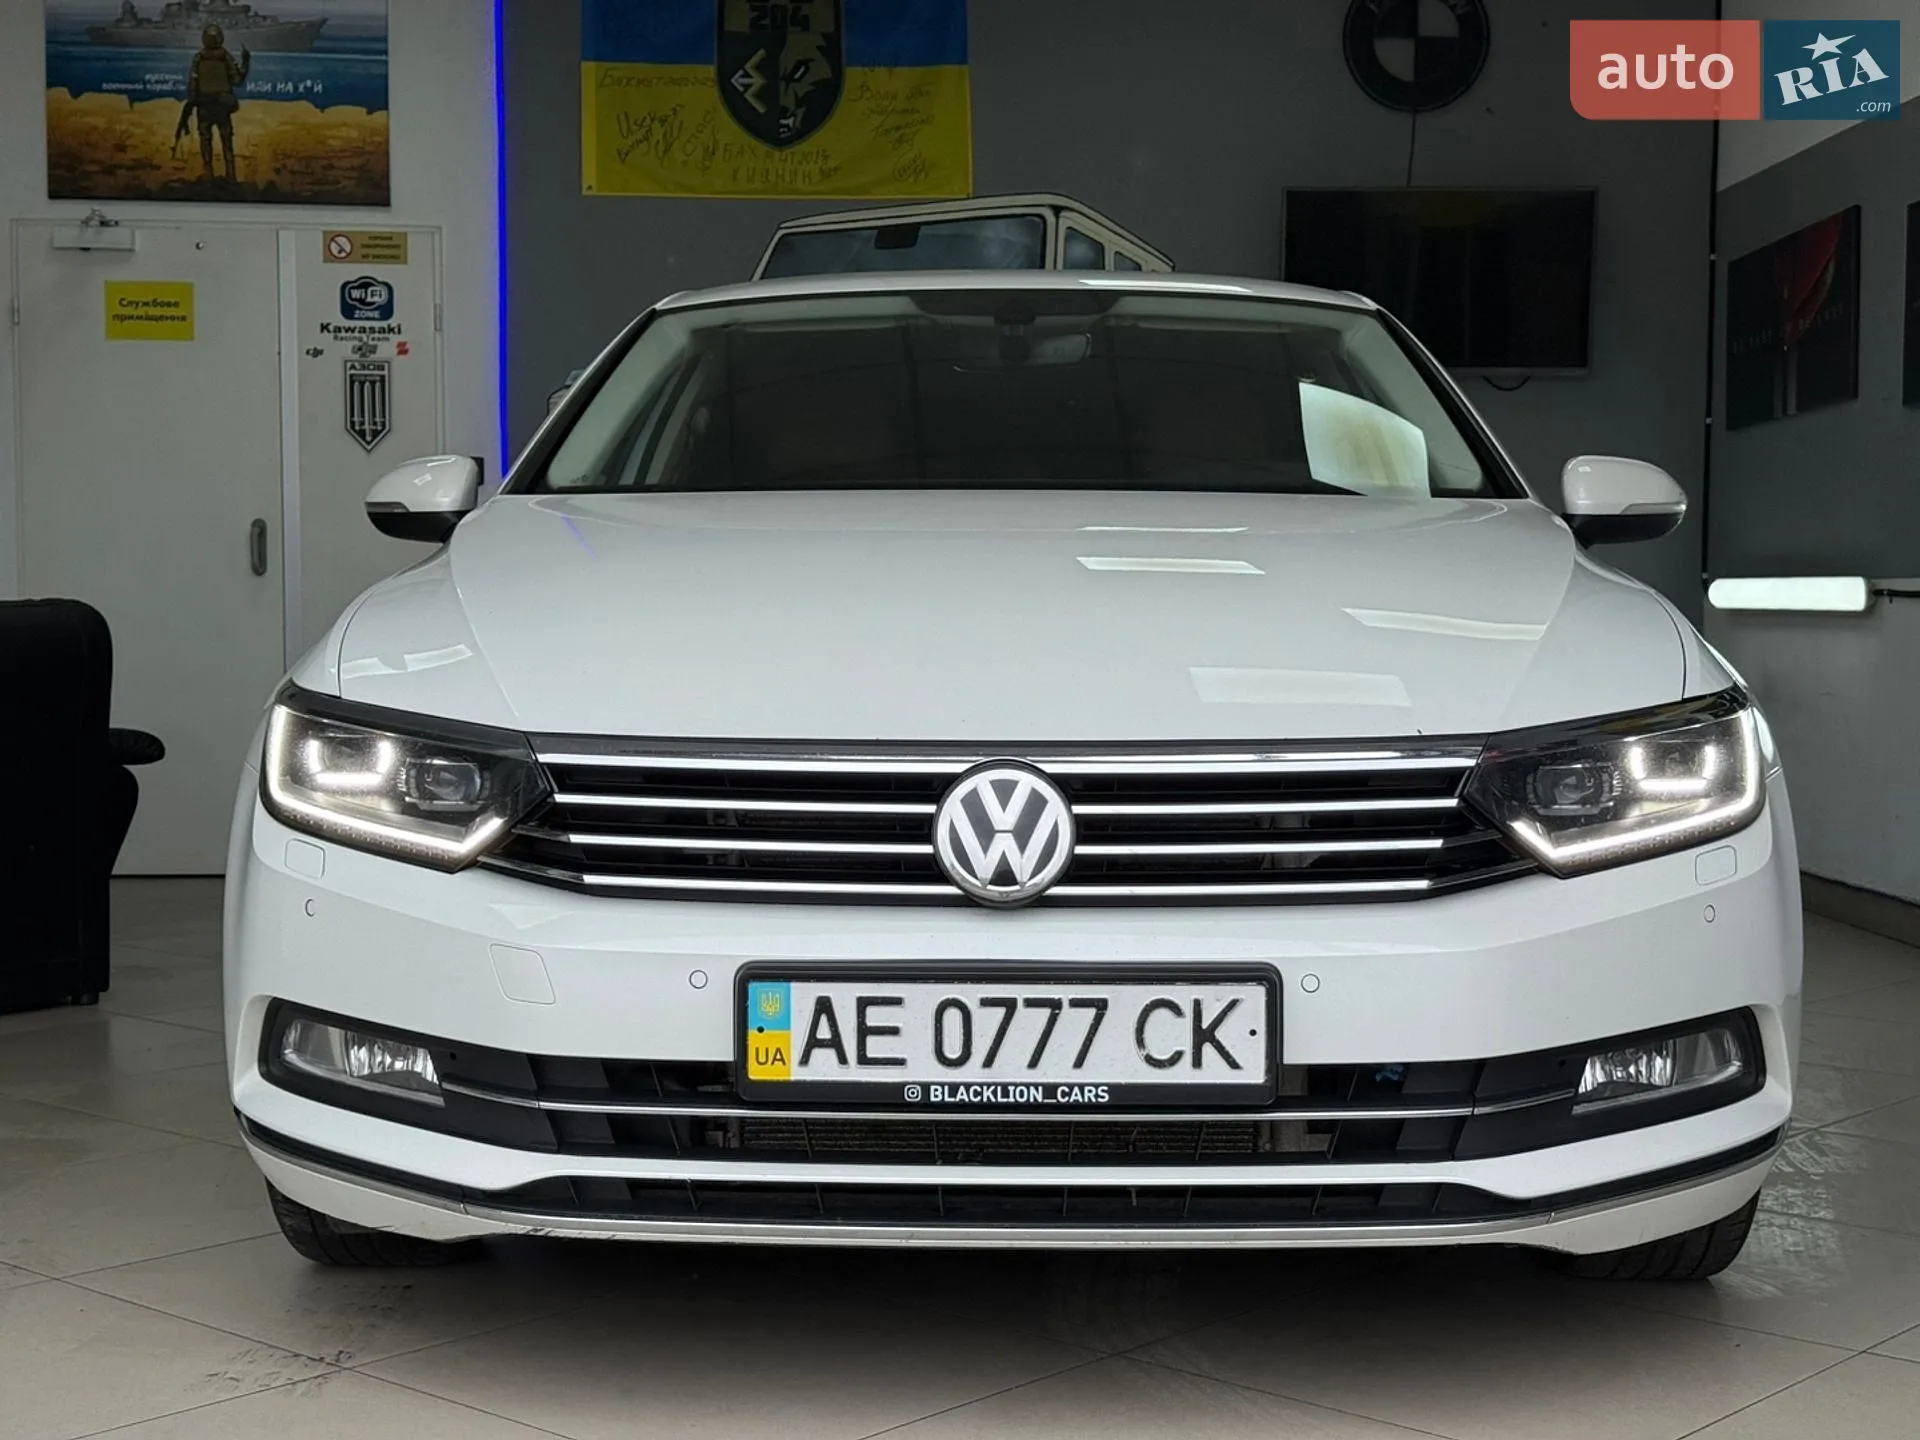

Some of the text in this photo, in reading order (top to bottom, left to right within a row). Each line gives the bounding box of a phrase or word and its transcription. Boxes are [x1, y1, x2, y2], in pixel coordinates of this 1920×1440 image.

[118, 297, 180, 310] Службове
[353, 310, 381, 319] ZONE
[320, 322, 402, 336] Kawasaki
[797, 994, 1243, 1070] AE 0777 CK
[754, 1047, 788, 1067] UA
[929, 1085, 1110, 1104] BLACKLION_CARS
